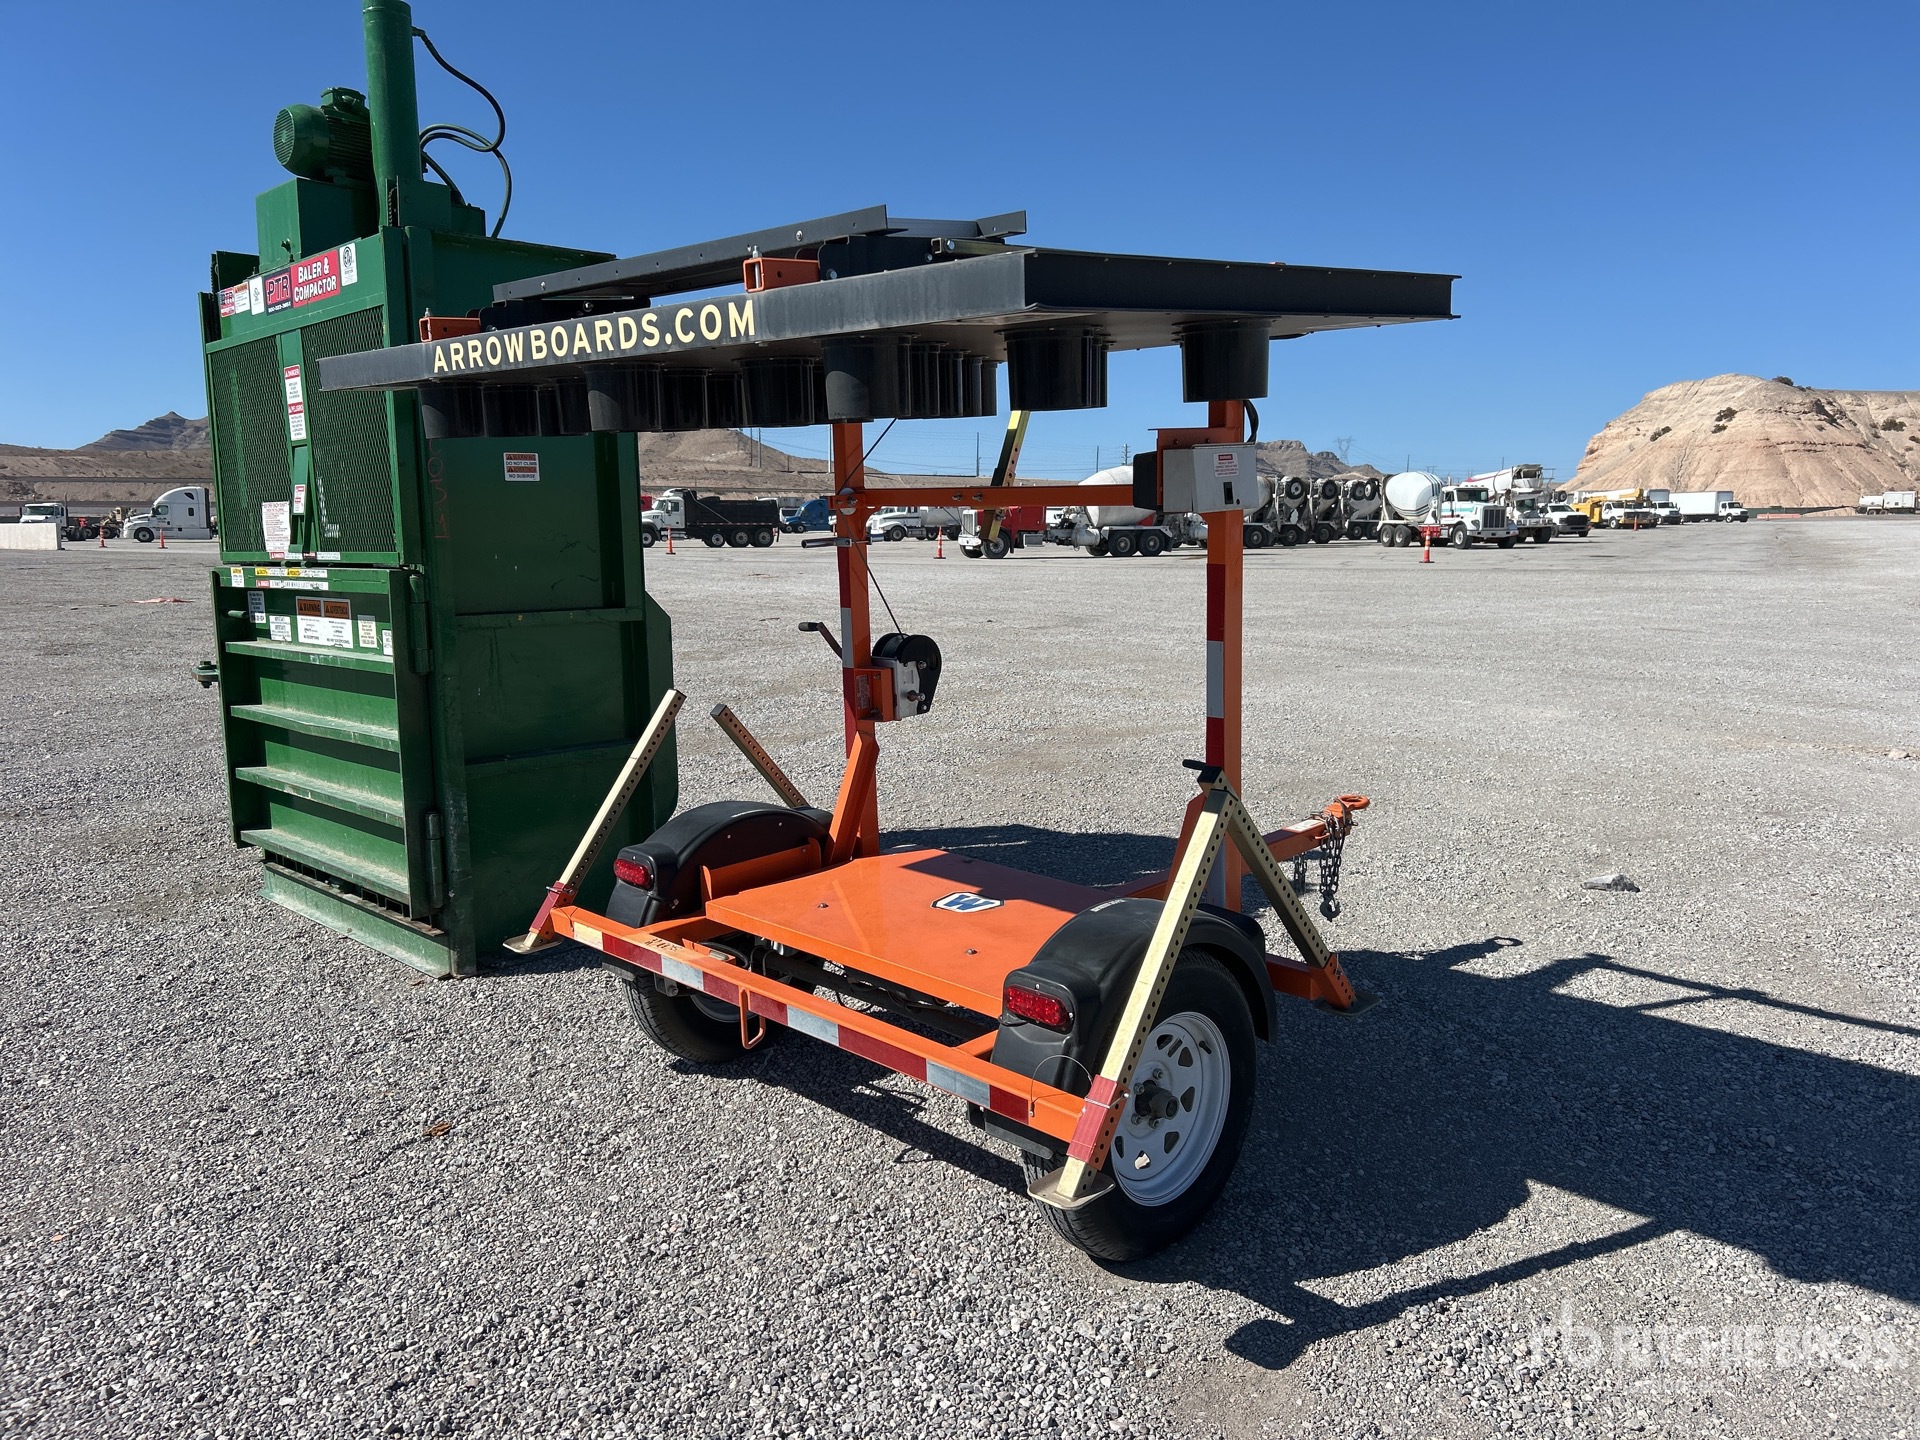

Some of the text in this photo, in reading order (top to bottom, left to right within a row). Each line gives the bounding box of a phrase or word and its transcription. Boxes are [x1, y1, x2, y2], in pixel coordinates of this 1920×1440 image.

[298, 261, 322, 284] BALER
[323, 256, 330, 275] &
[266, 275, 290, 305] PTR
[294, 275, 337, 303] COMPACTOR
[433, 299, 756, 374] ARROWBOARDS.COM
